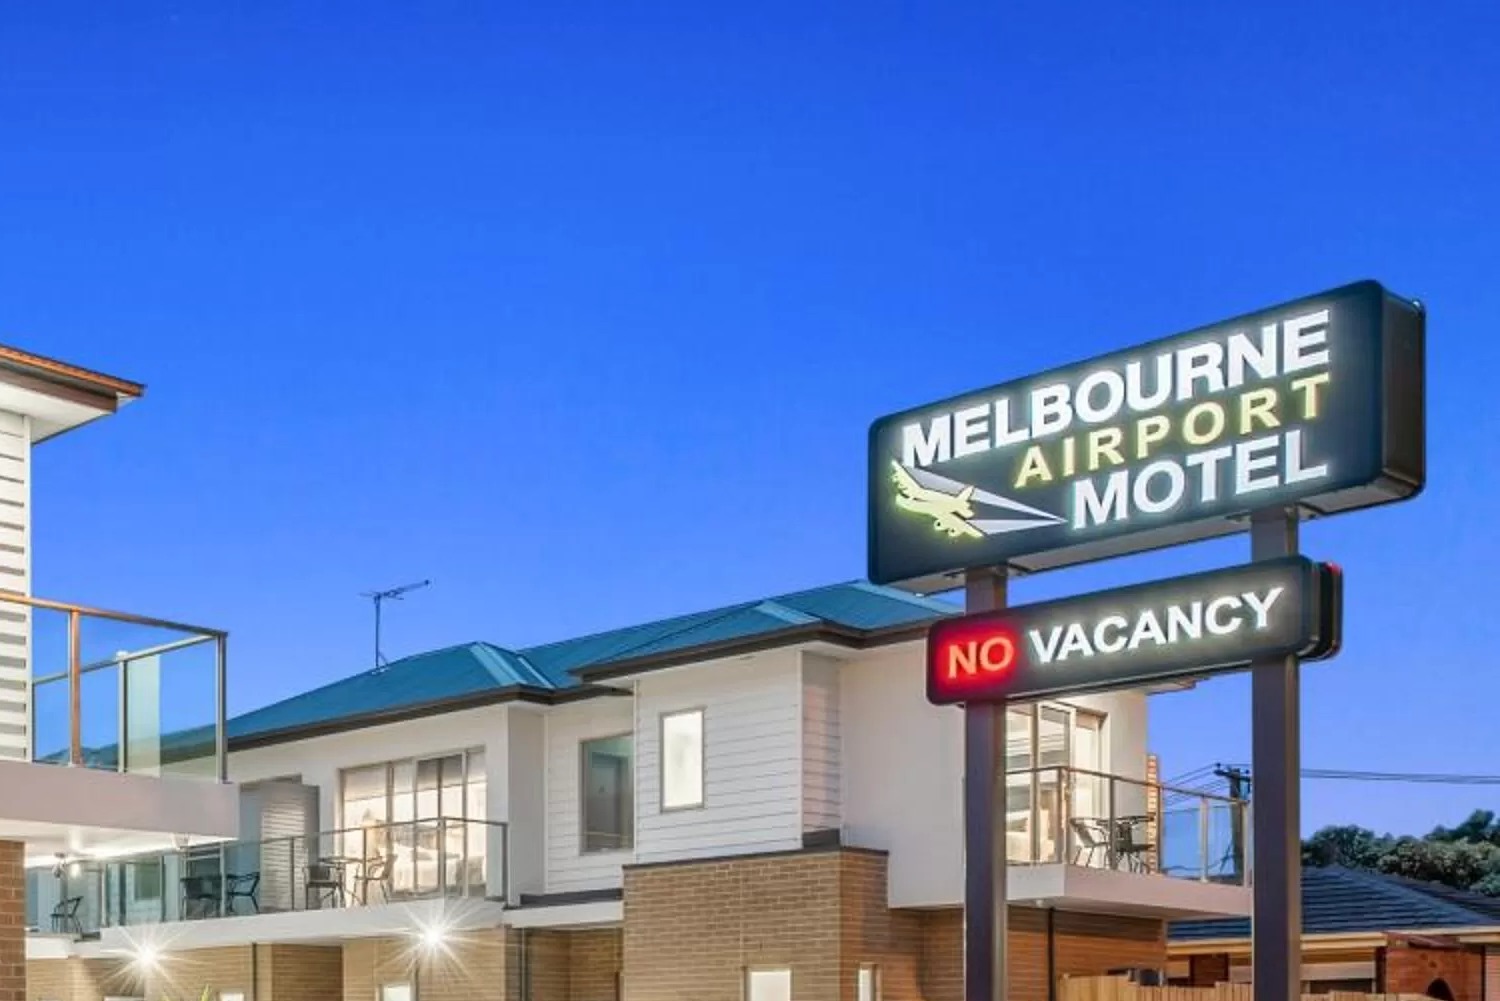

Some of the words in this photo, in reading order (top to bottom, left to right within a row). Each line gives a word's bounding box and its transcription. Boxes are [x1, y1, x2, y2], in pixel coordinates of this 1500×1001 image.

[902, 309, 1331, 467] MELBOURNE
[1014, 374, 1329, 488] AIRPORT
[1072, 429, 1327, 530] MOTEL
[947, 636, 1014, 679] NO
[1028, 587, 1284, 664] VACANCY
